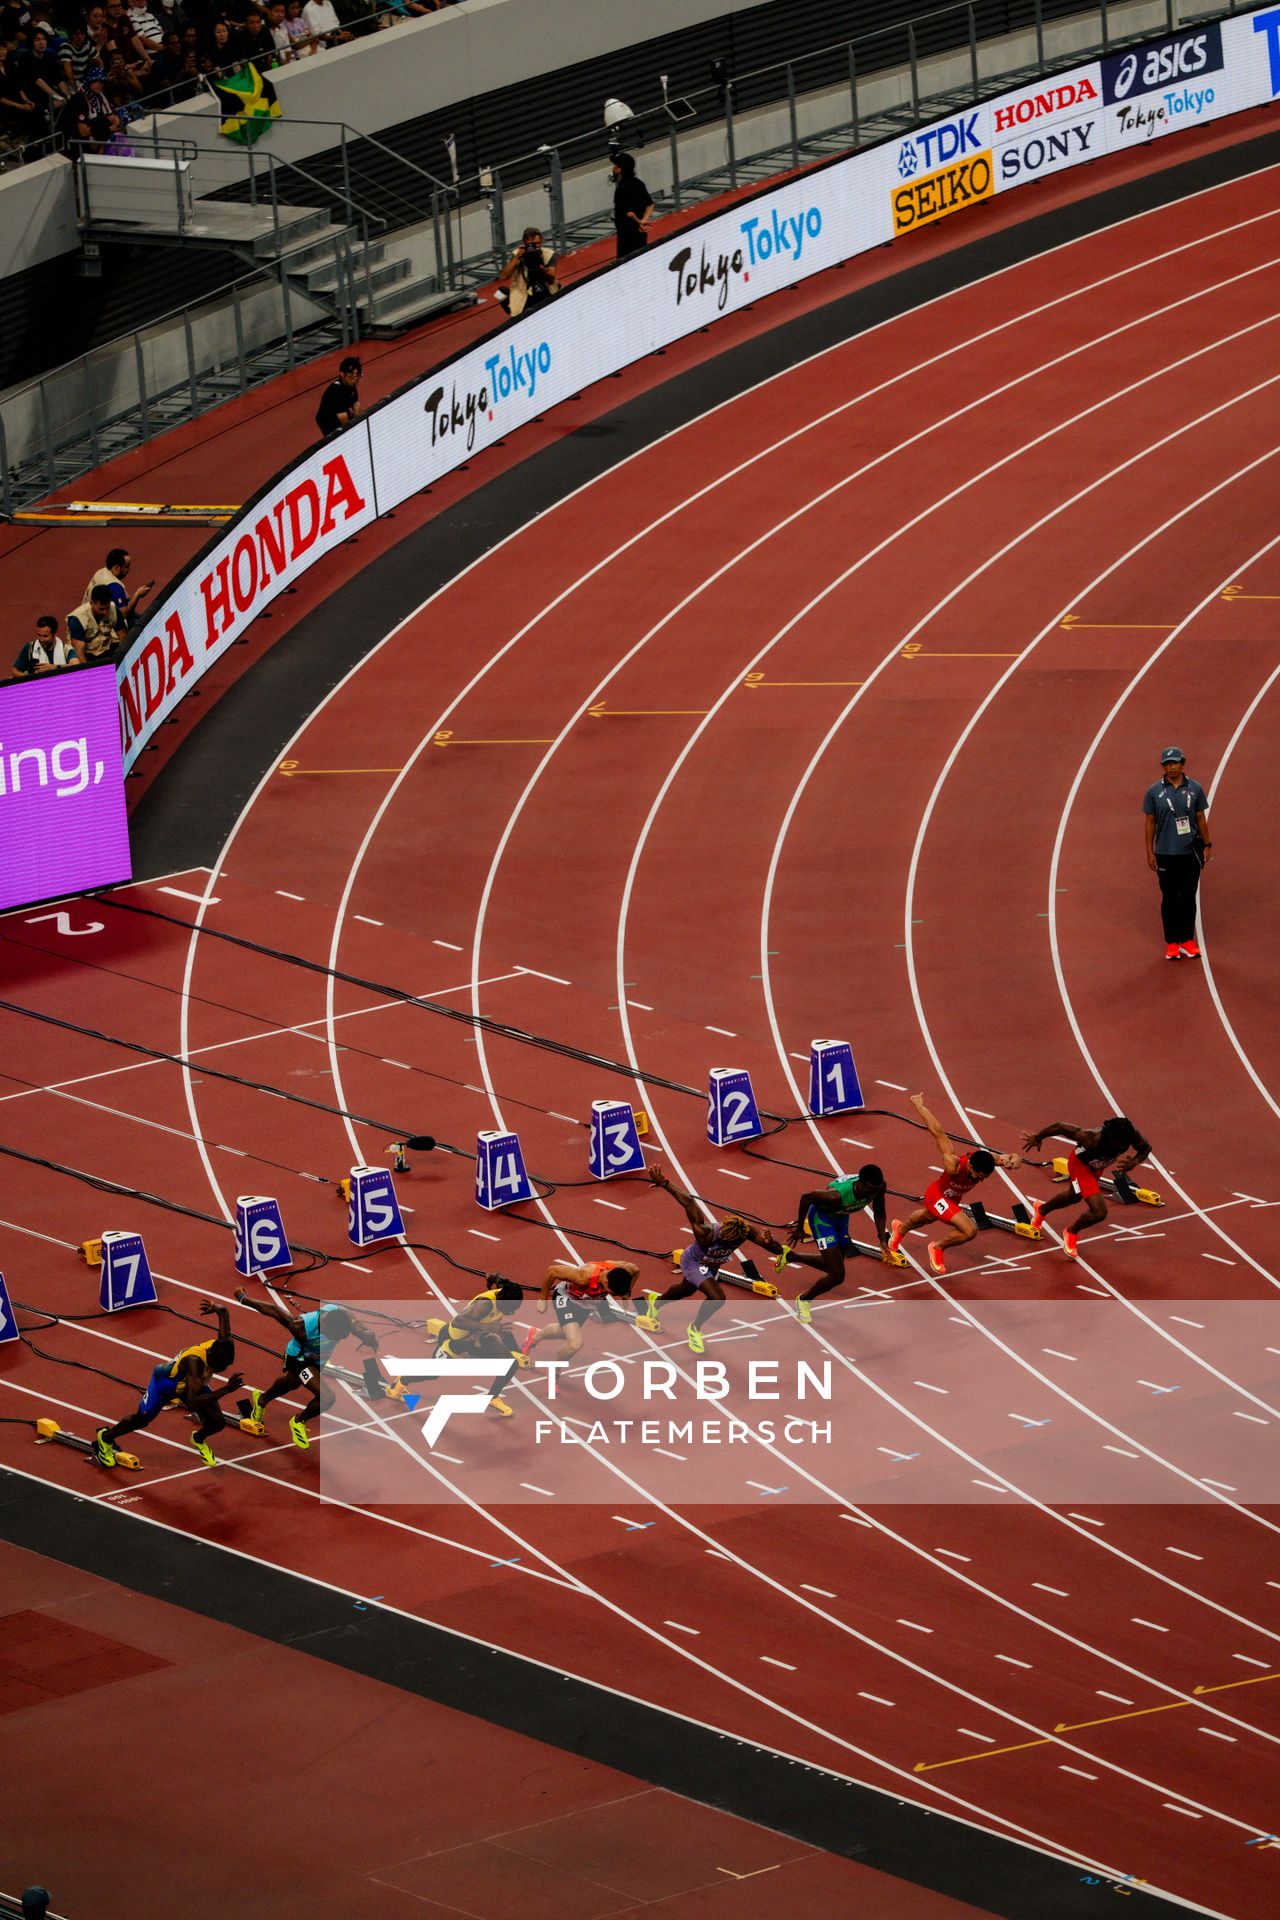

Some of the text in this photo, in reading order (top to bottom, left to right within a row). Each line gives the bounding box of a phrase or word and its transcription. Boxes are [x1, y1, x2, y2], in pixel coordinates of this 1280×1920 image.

[1143, 35, 1207, 86] asics
[995, 78, 1098, 134] HONDA
[1116, 87, 1215, 137] Tokyo Tokyo
[916, 112, 982, 168] TDK
[1001, 121, 1096, 181] SONY
[894, 157, 991, 230] SEIKO
[669, 207, 822, 311] Tokyo Tokyo
[424, 341, 551, 451] Tokyo Tokyo
[200, 453, 366, 652] HONDA
[827, 1063, 846, 1104] 1
[722, 1091, 754, 1135] 2
[604, 1122, 635, 1166] 3
[494, 1152, 522, 1194] 4
[363, 1187, 394, 1232] 5
[937, 1202, 945, 1211] 3
[250, 1218, 281, 1262] 6
[113, 1253, 141, 1299] 7
[558, 1297, 564, 1306] 6
[301, 1370, 309, 1380] 8
